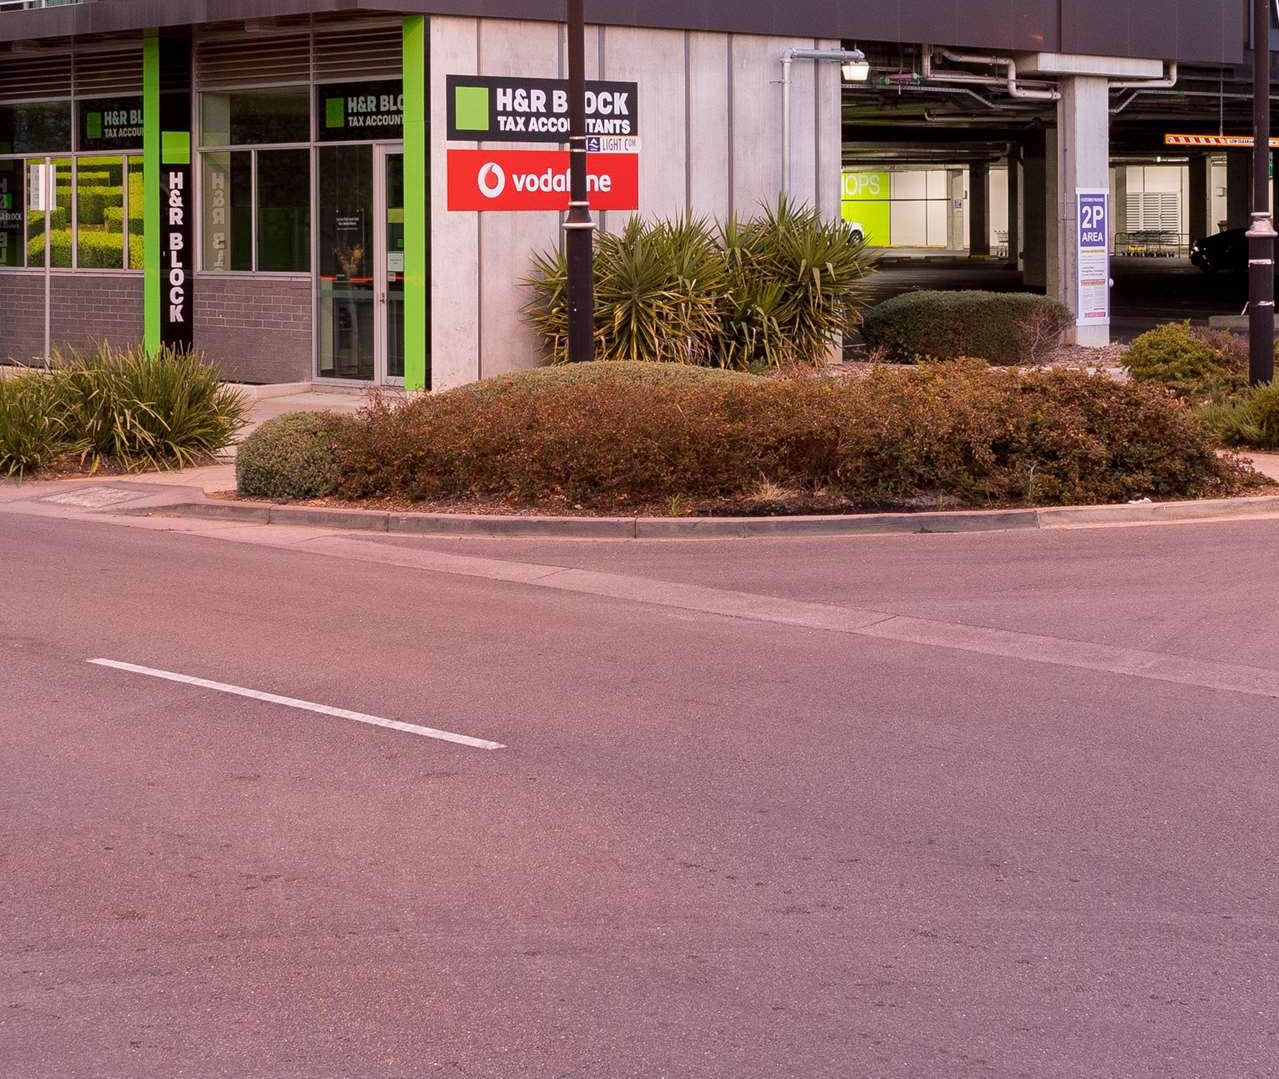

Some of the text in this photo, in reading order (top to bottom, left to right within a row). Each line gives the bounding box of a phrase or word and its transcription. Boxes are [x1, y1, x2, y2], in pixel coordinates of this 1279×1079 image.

[347, 94, 404, 113] H&R BLO
[496, 87, 629, 116] H&R BOCK
[104, 111, 128, 126] H&R
[347, 116, 364, 128] TAX
[497, 116, 631, 135] TAX ACCOTANTS
[104, 127, 118, 138] TAX
[602, 138, 622, 151] LIGHT
[842, 174, 881, 196] OPS
[1081, 205, 1104, 229] 2P
[1081, 231, 1104, 243] AREA
[168, 171, 184, 323] H&R BLOCK
